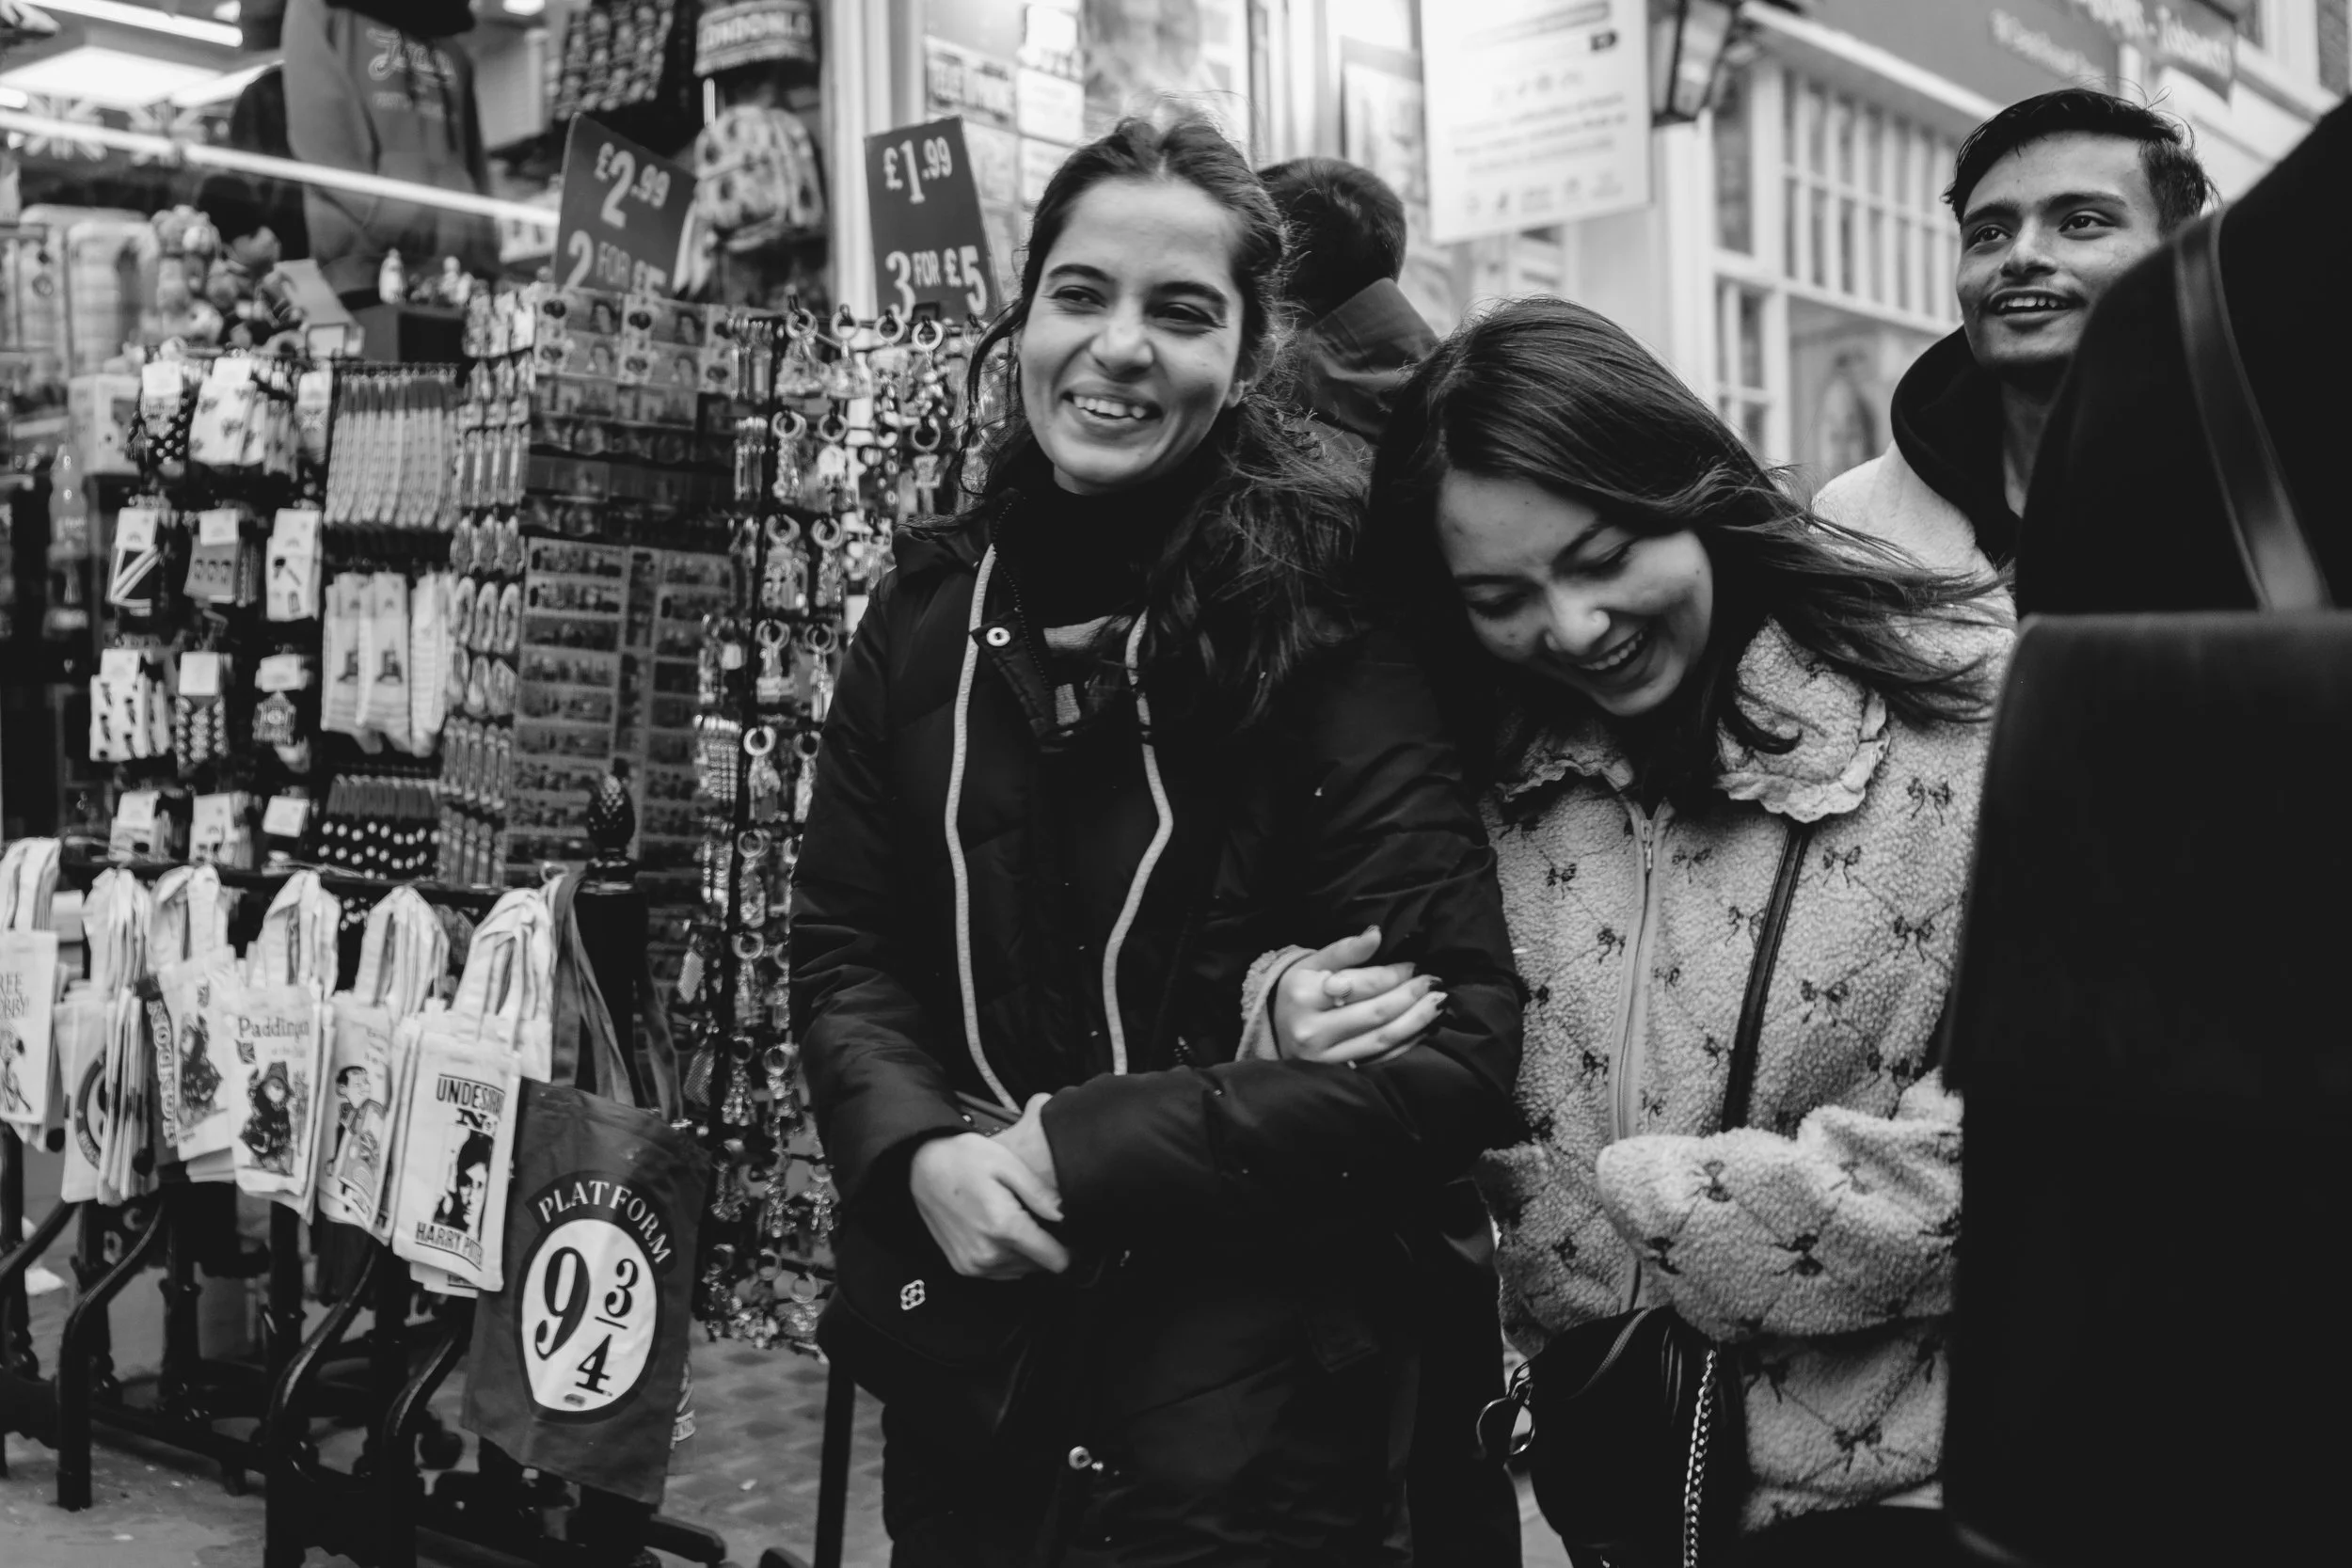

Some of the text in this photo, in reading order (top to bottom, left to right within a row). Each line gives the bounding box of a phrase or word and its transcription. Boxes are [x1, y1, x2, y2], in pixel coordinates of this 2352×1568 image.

[594, 141, 671, 229] £2.99
[882, 136, 952, 204] £1.99
[564, 230, 594, 288] 2
[596, 241, 631, 291] FOR
[885, 245, 988, 323] 3 FOR £5
[416, 1222, 463, 1252] HARRY
[538, 1180, 672, 1264] PLATFORM
[534, 1246, 591, 1361] 9
[604, 1259, 639, 1317] 3
[575, 1333, 614, 1397] 4
